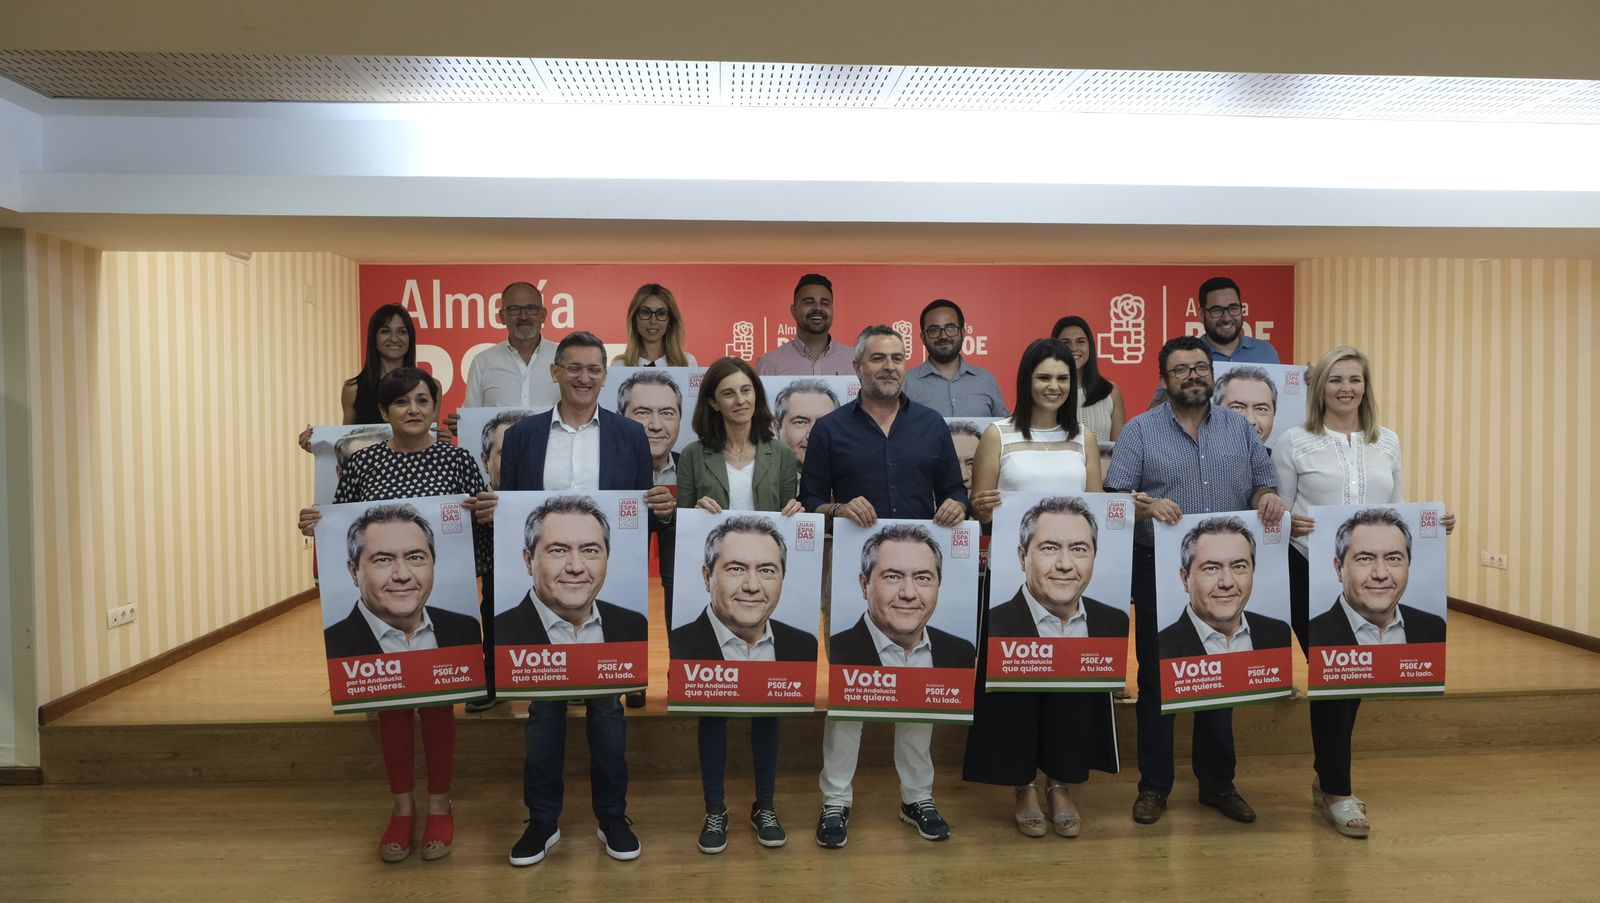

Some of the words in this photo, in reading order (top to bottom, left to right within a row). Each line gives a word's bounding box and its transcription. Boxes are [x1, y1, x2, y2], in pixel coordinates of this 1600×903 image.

[1001, 641, 1053, 658] Vota
[509, 648, 566, 667] Vota
[1321, 649, 1372, 666] Vota
[342, 659, 402, 678] Vota
[433, 668, 453, 676] PSOE
[684, 664, 738, 682] Vota
[1020, 665, 1054, 674] quieres.
[1172, 659, 1222, 678] Vota
[367, 675, 402, 684] Andalucía
[512, 675, 530, 683] que
[532, 674, 569, 683] quieres.
[842, 669, 896, 687] Vota
[1192, 675, 1222, 683] Andalucía
[1341, 672, 1374, 681] quieres.
[347, 686, 365, 695] que
[368, 682, 405, 693] quieres.
[685, 690, 702, 698] que
[704, 689, 740, 698] quieres.
[1175, 685, 1191, 694] que
[1192, 682, 1224, 692] quieres.
[844, 694, 861, 702] que
[863, 694, 898, 702] quieres.
